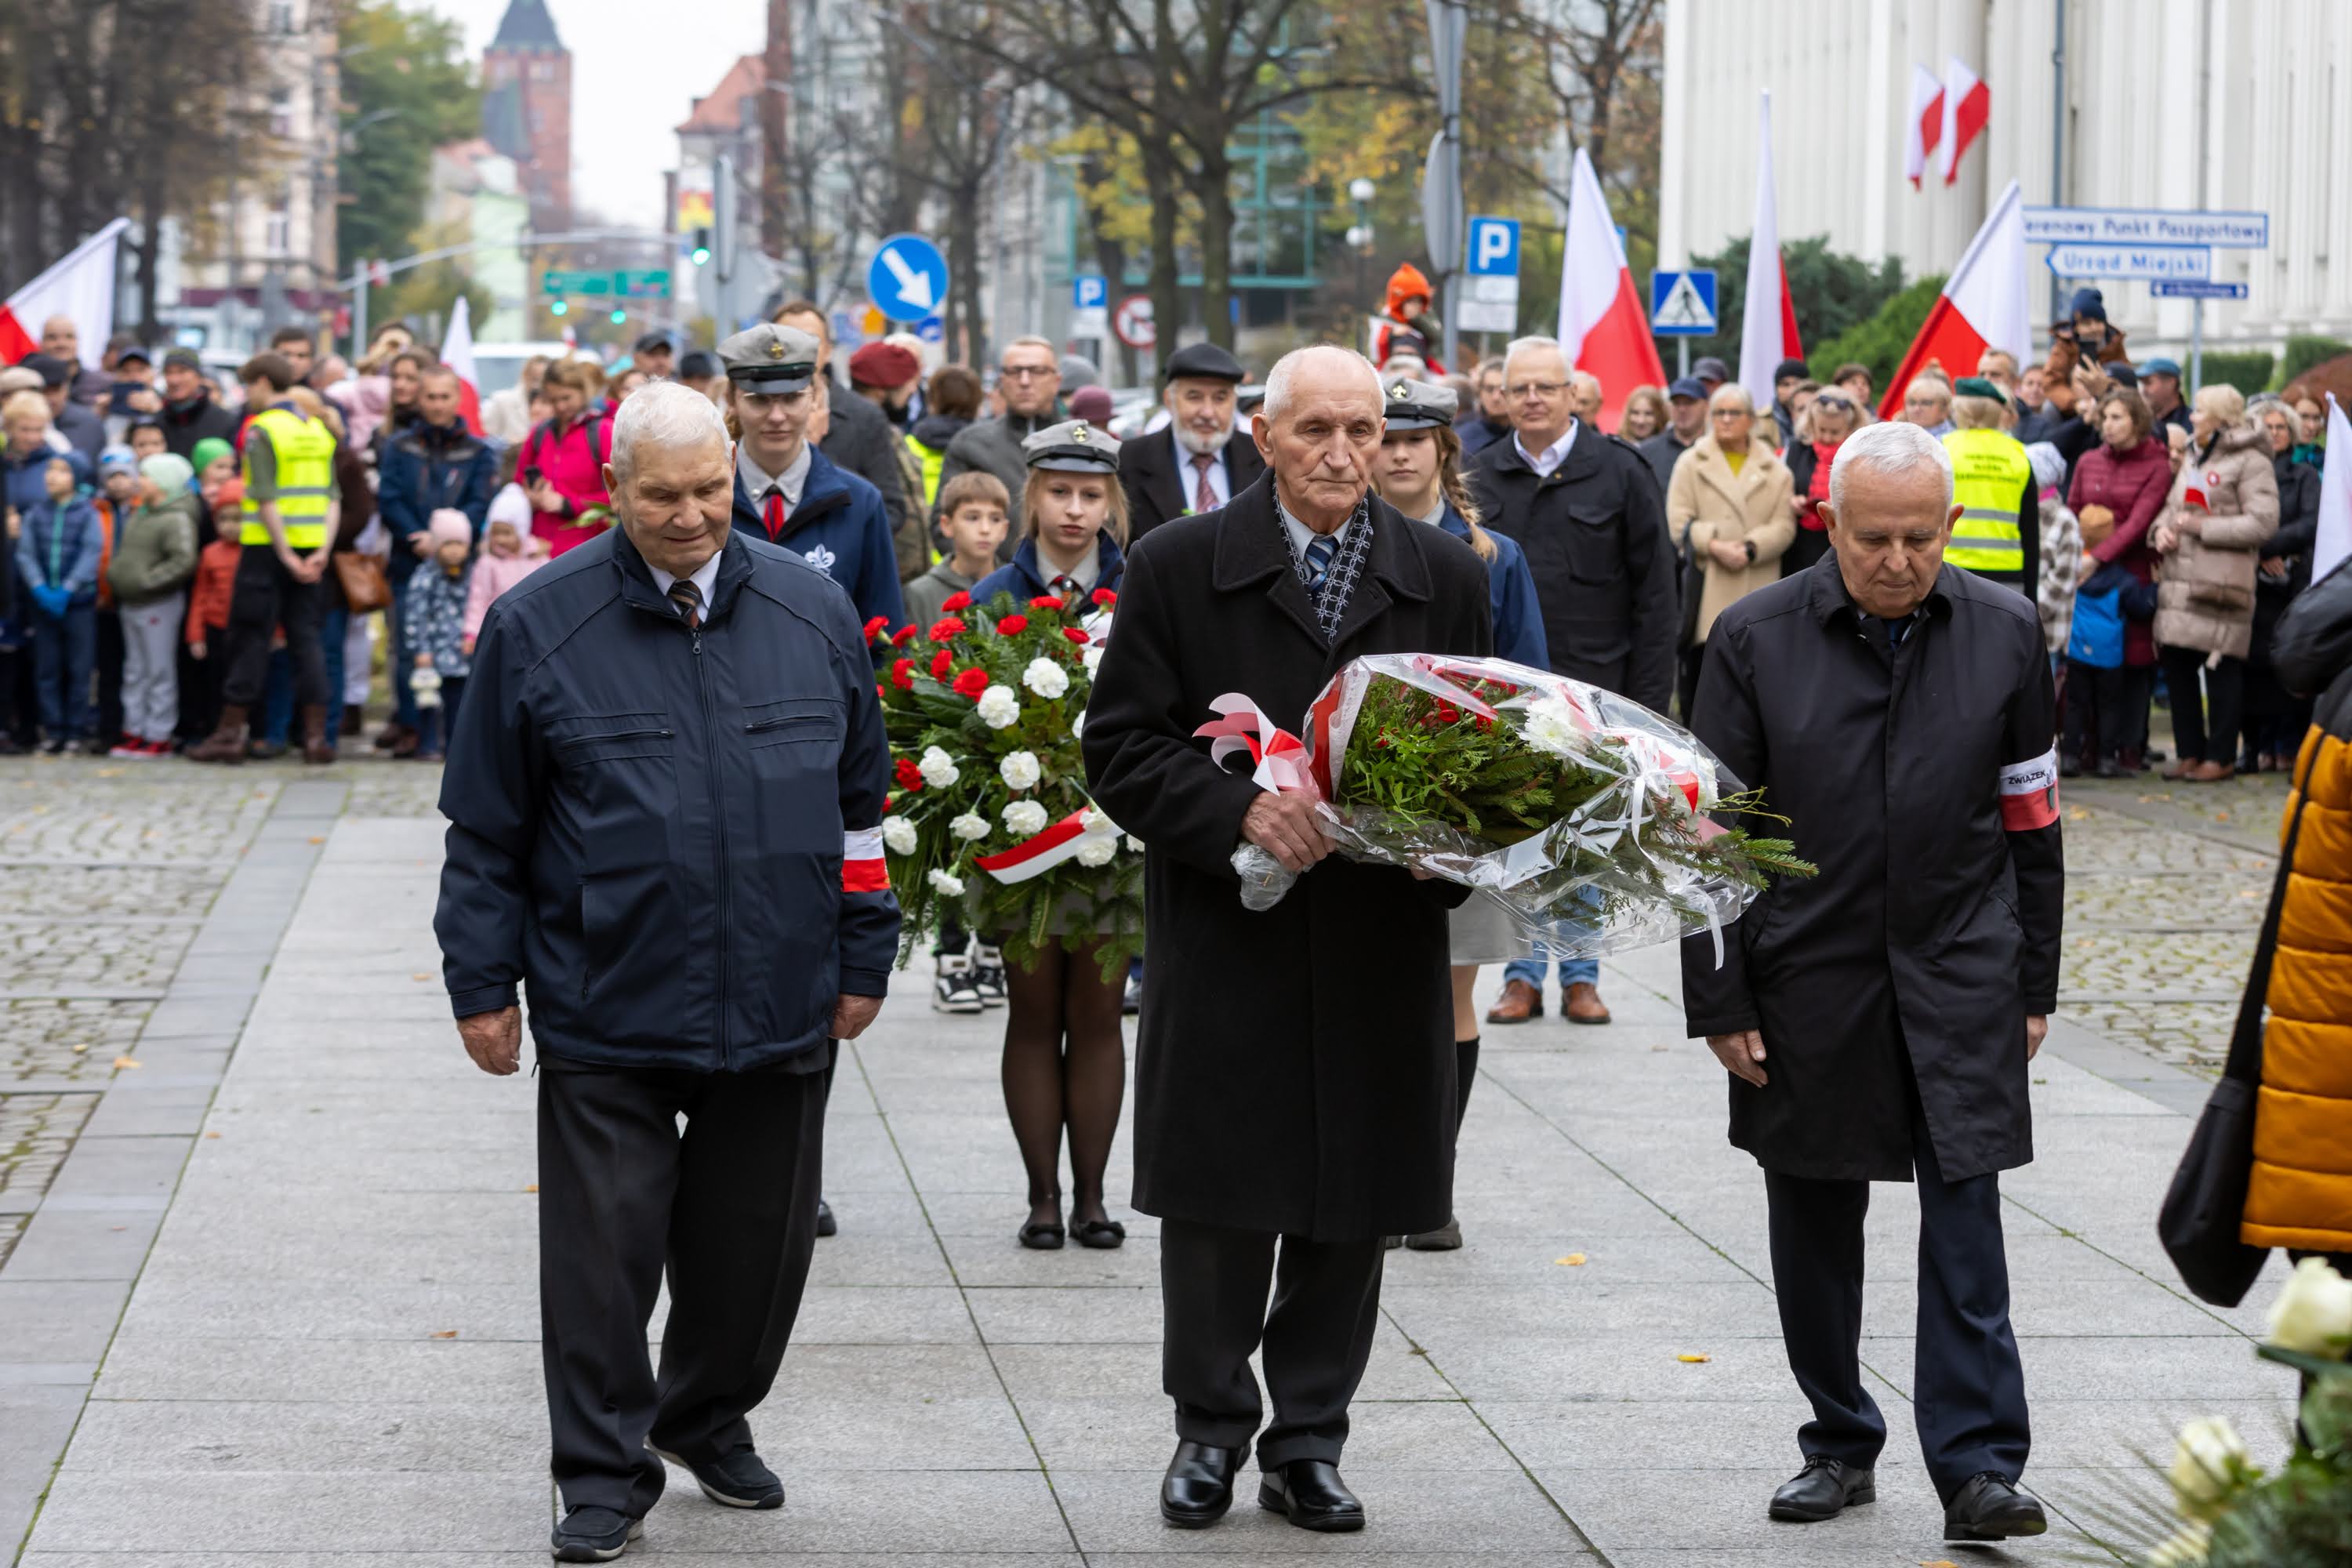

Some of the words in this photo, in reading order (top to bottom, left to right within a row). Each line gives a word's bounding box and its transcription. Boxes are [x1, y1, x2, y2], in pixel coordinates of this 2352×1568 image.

[2024, 221, 2094, 240] erenowy
[2104, 217, 2150, 236] Punkt
[2158, 219, 2263, 245] Paszportowy
[1478, 223, 1511, 270] P
[2063, 251, 2121, 273] Urząd
[2132, 252, 2204, 276] Miejski
[1080, 278, 1103, 307] P
[2008, 769, 2047, 785] ZWIĄZEK
